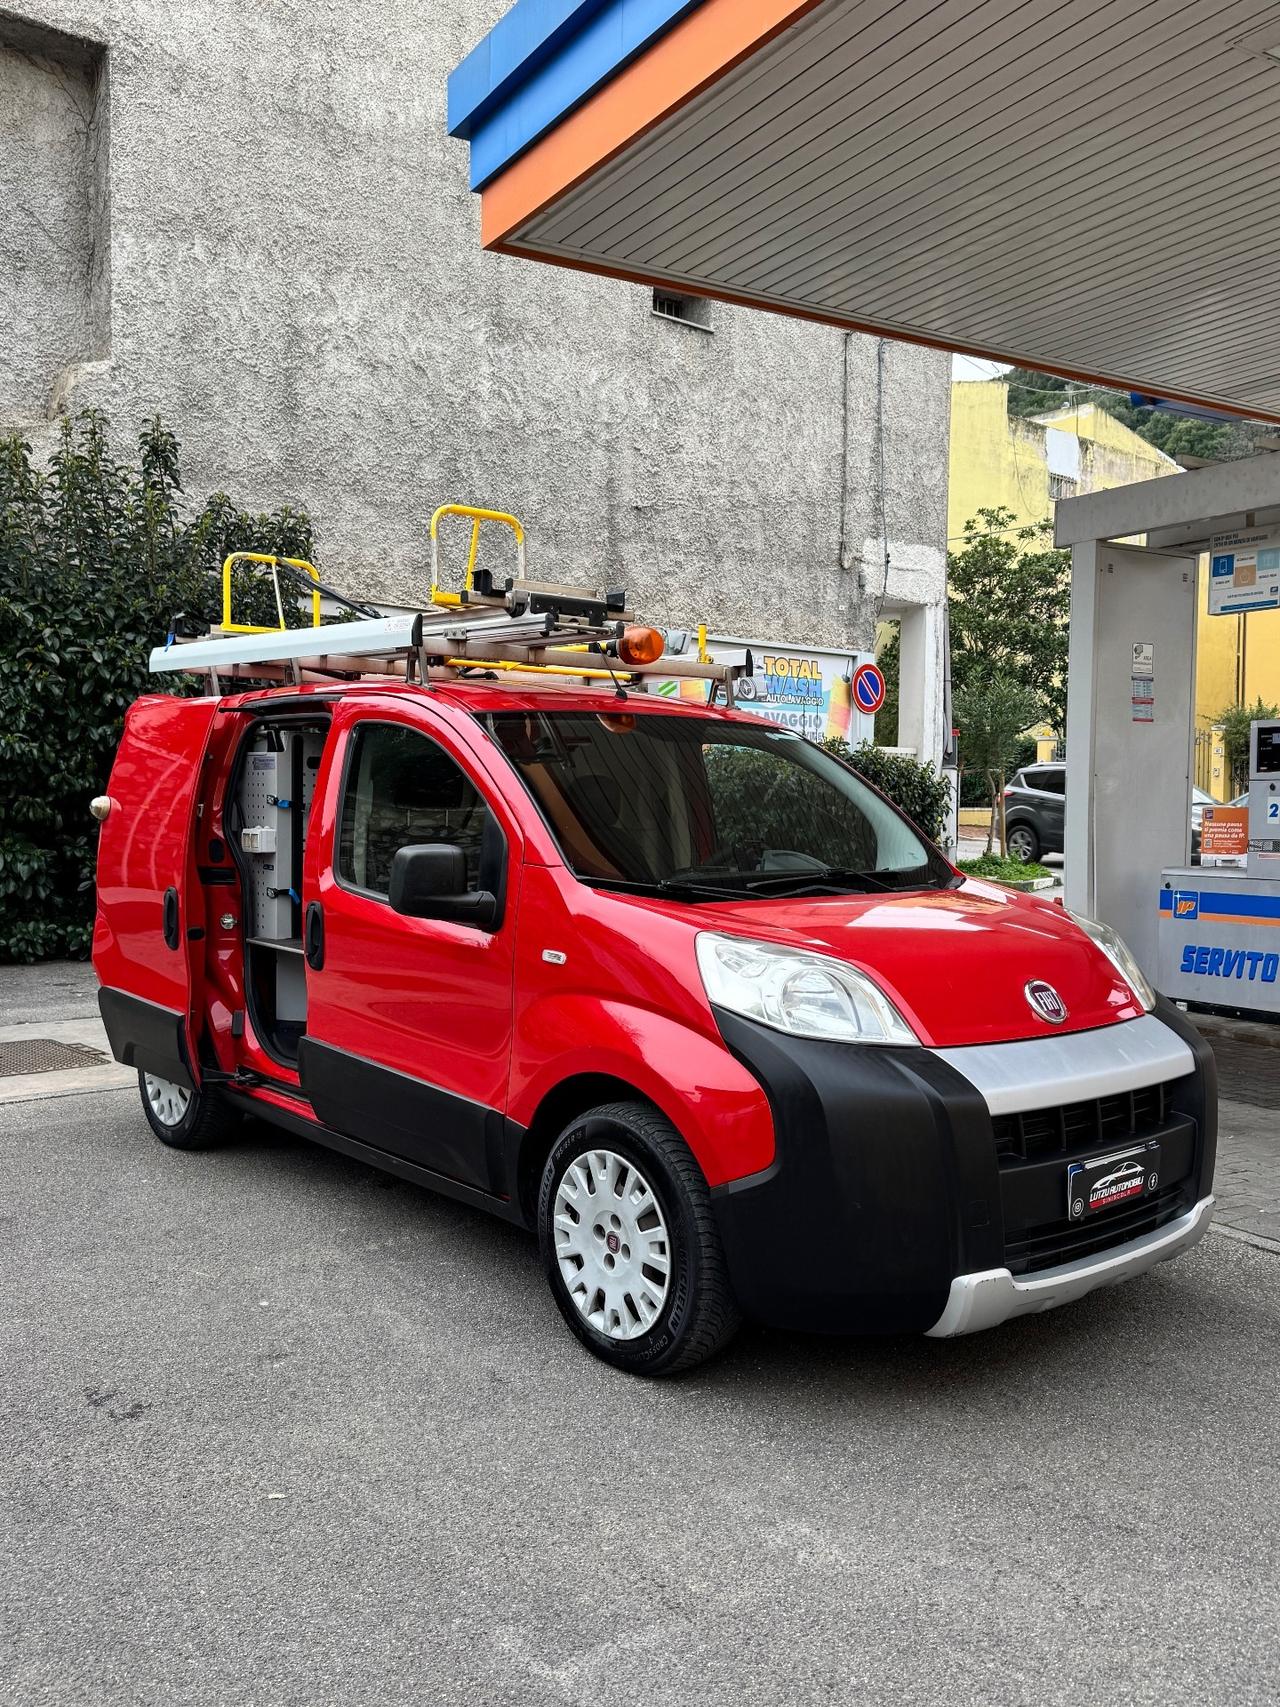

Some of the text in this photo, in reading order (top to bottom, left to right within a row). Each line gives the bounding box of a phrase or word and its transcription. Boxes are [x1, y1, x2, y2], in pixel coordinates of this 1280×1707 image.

[764, 656, 822, 679] TOTAL
[764, 674, 822, 697] WASH
[766, 694, 824, 706] AUTOLAVAGGIO
[1268, 803, 1279, 818] 2
[1177, 901, 1196, 914] IP
[1180, 945, 1279, 983] SERVITO
[1034, 991, 1060, 1011] FIAT
[669, 1248, 689, 1333] MICHELIN
